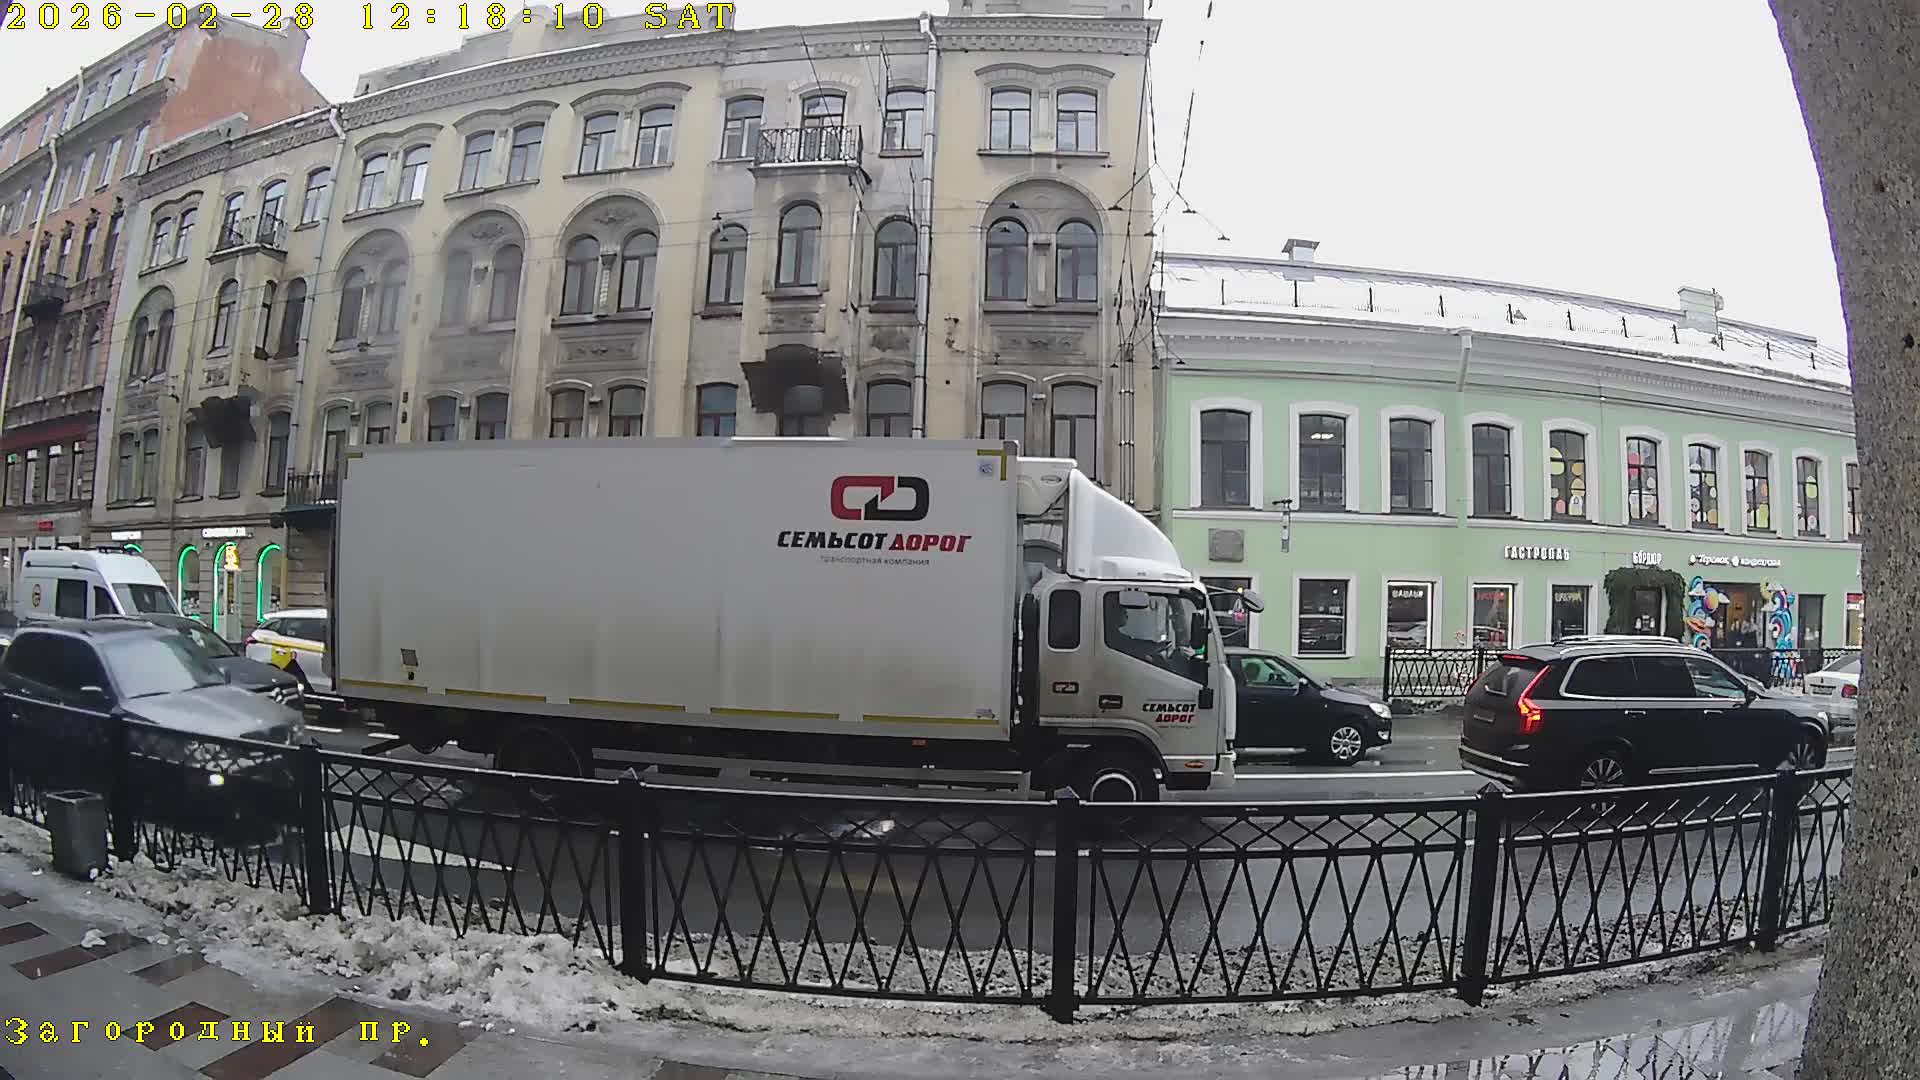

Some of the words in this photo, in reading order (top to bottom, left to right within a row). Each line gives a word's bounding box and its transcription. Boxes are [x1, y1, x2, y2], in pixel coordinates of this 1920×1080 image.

[777, 530, 888, 550] СЕМЬСОТ
[888, 533, 972, 552] ДОРОГ
[884, 558, 930, 567] компания
[1142, 703, 1196, 713] СЕМЬСОТ
[1155, 713, 1195, 723] ДОРОГ
